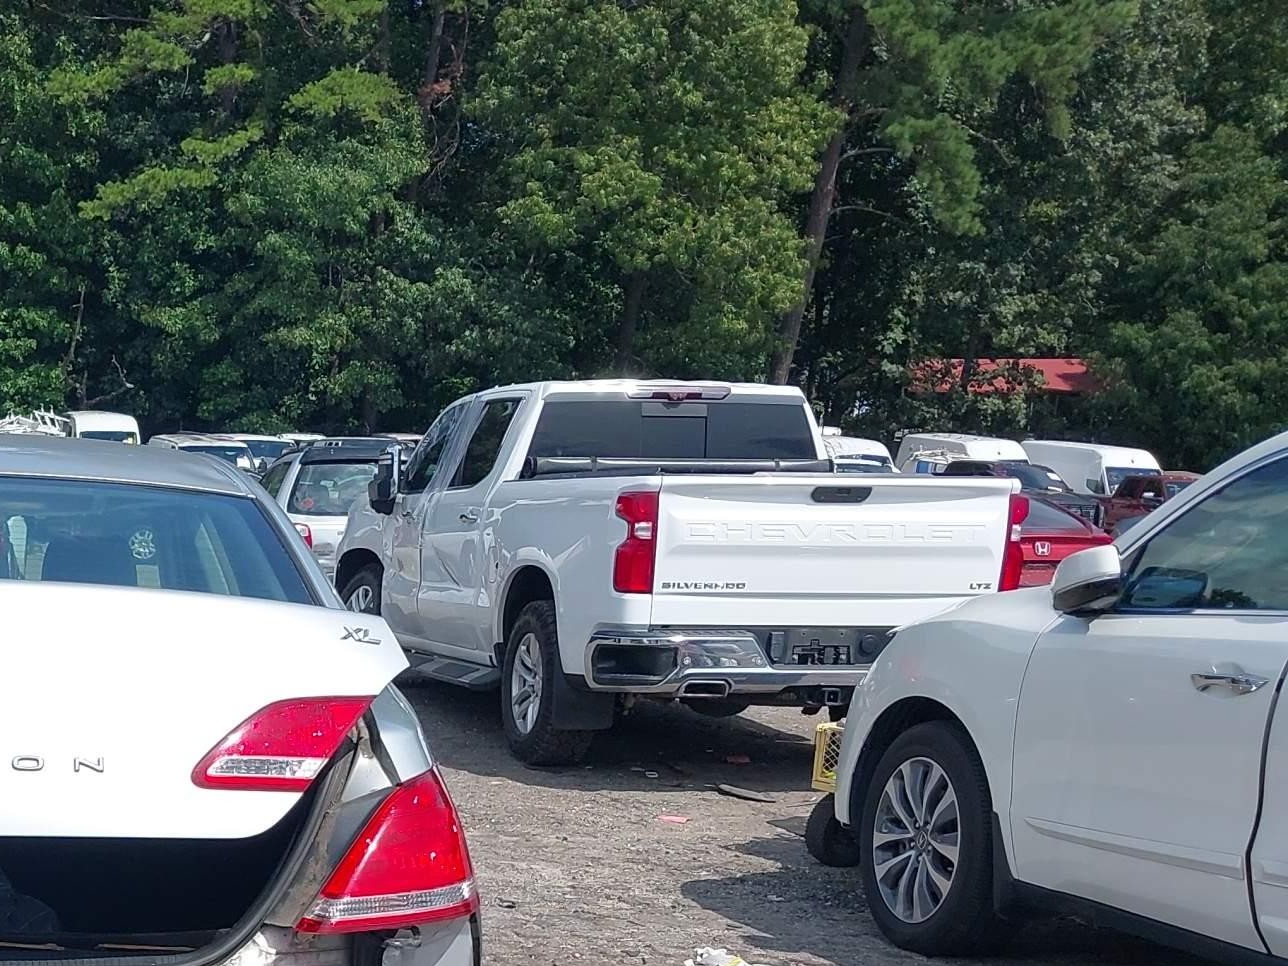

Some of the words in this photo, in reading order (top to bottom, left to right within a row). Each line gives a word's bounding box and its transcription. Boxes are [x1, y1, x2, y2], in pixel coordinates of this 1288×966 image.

[684, 521, 987, 543] CHEVROLET
[661, 581, 746, 590] SILVERADO
[969, 582, 992, 590] LTZ
[339, 625, 382, 646] XL
